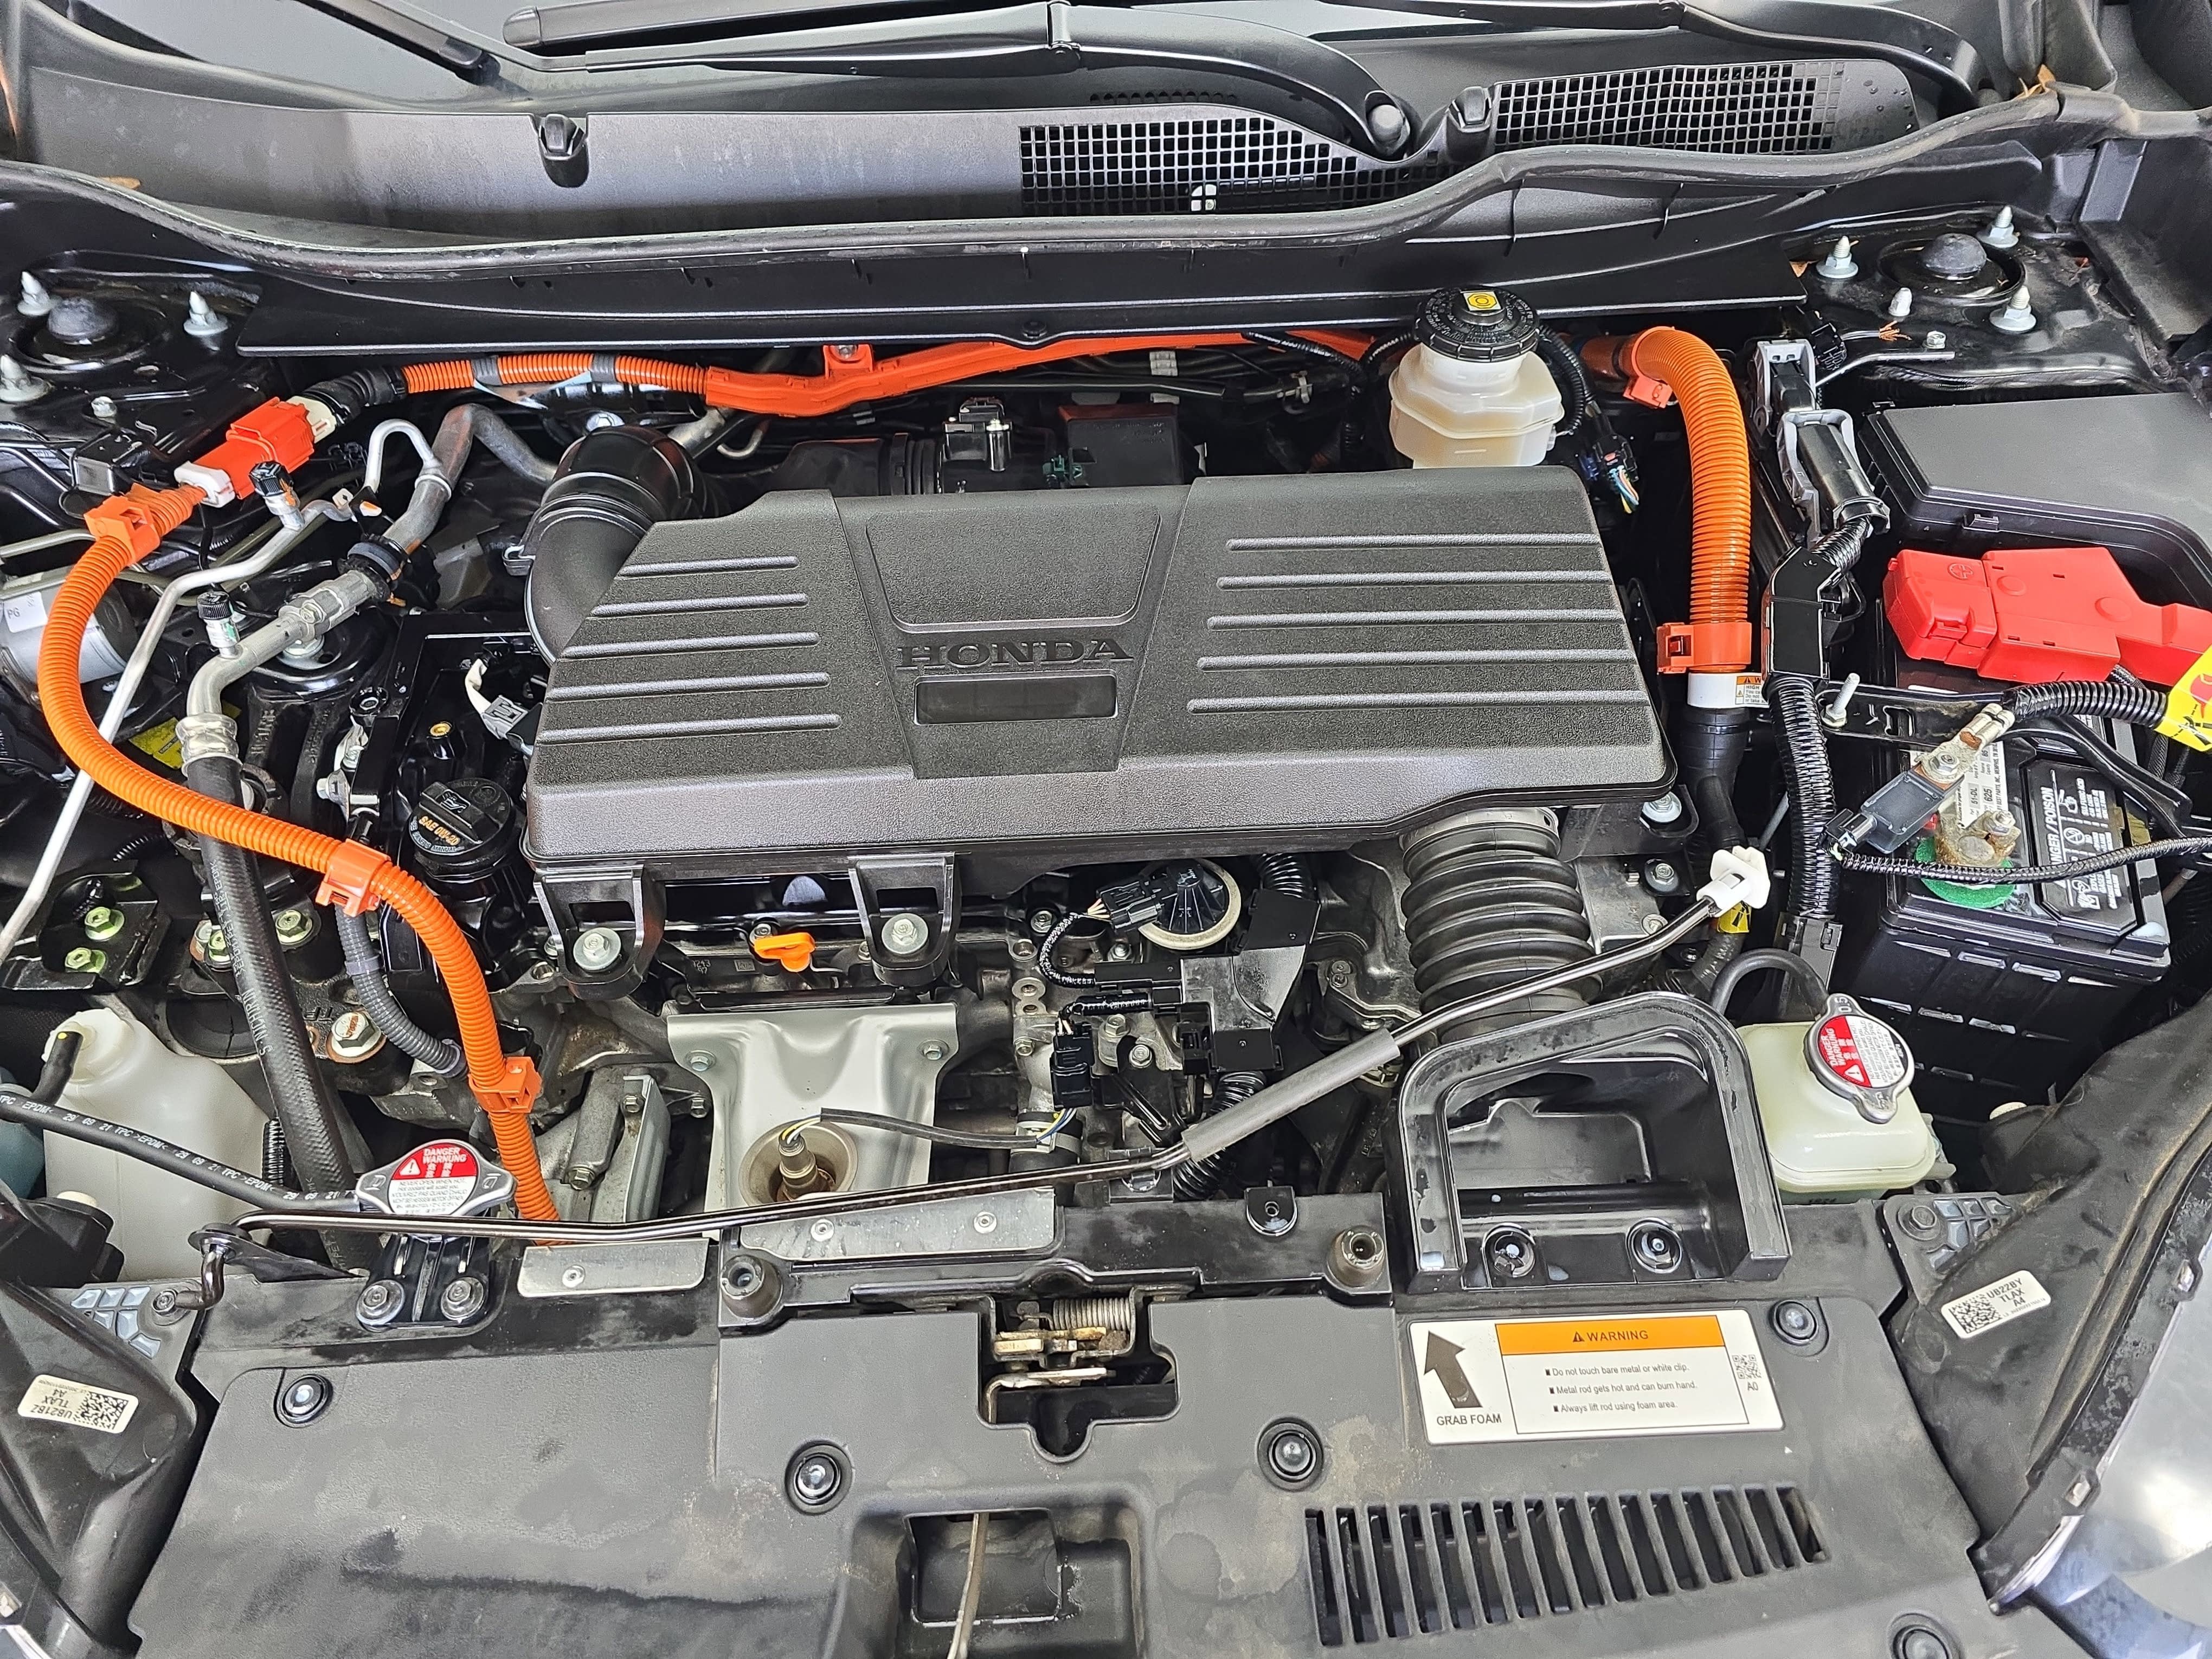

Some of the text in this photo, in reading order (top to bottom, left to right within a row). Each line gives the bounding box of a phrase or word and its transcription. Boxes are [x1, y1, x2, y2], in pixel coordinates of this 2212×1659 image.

[896, 638, 1134, 670] HONDA
[1983, 788, 1992, 801] 625
[419, 815, 461, 846] SAE 0W-20
[1835, 996, 1852, 1013] 0.5
[1820, 1035, 1838, 1066] DANGER
[1825, 1028, 1847, 1065] WARNUNG
[423, 1147, 460, 1155] DANGER
[422, 1154, 467, 1163] WARNUNG
[1986, 1277, 2022, 1299] UB22BY
[1999, 1288, 2025, 1303] TLAX
[2012, 1296, 2026, 1307] A4
[1586, 1330, 1649, 1341] WARNING
[1552, 1368, 1564, 1376] Do
[1565, 1367, 1578, 1375] not
[1579, 1367, 1599, 1375] touch
[1621, 1365, 1641, 1373] metal
[1652, 1363, 1672, 1371] white
[1674, 1362, 1690, 1372] clip.
[1556, 1386, 1577, 1394] Metal
[1579, 1385, 1591, 1393] rod
[1593, 1385, 1610, 1394] gets
[1611, 1384, 1624, 1392] hot
[1626, 1383, 1639, 1391] and
[41, 1396, 69, 1407] TLAX
[1561, 1404, 1587, 1413] Always
[1589, 1403, 1598, 1411] lift
[1600, 1402, 1612, 1410] rod
[1615, 1401, 1635, 1411] using
[1637, 1401, 1656, 1409] foam
[30, 1404, 73, 1418] UB21BZ
[1437, 1413, 1502, 1426] GRAB FOAM
